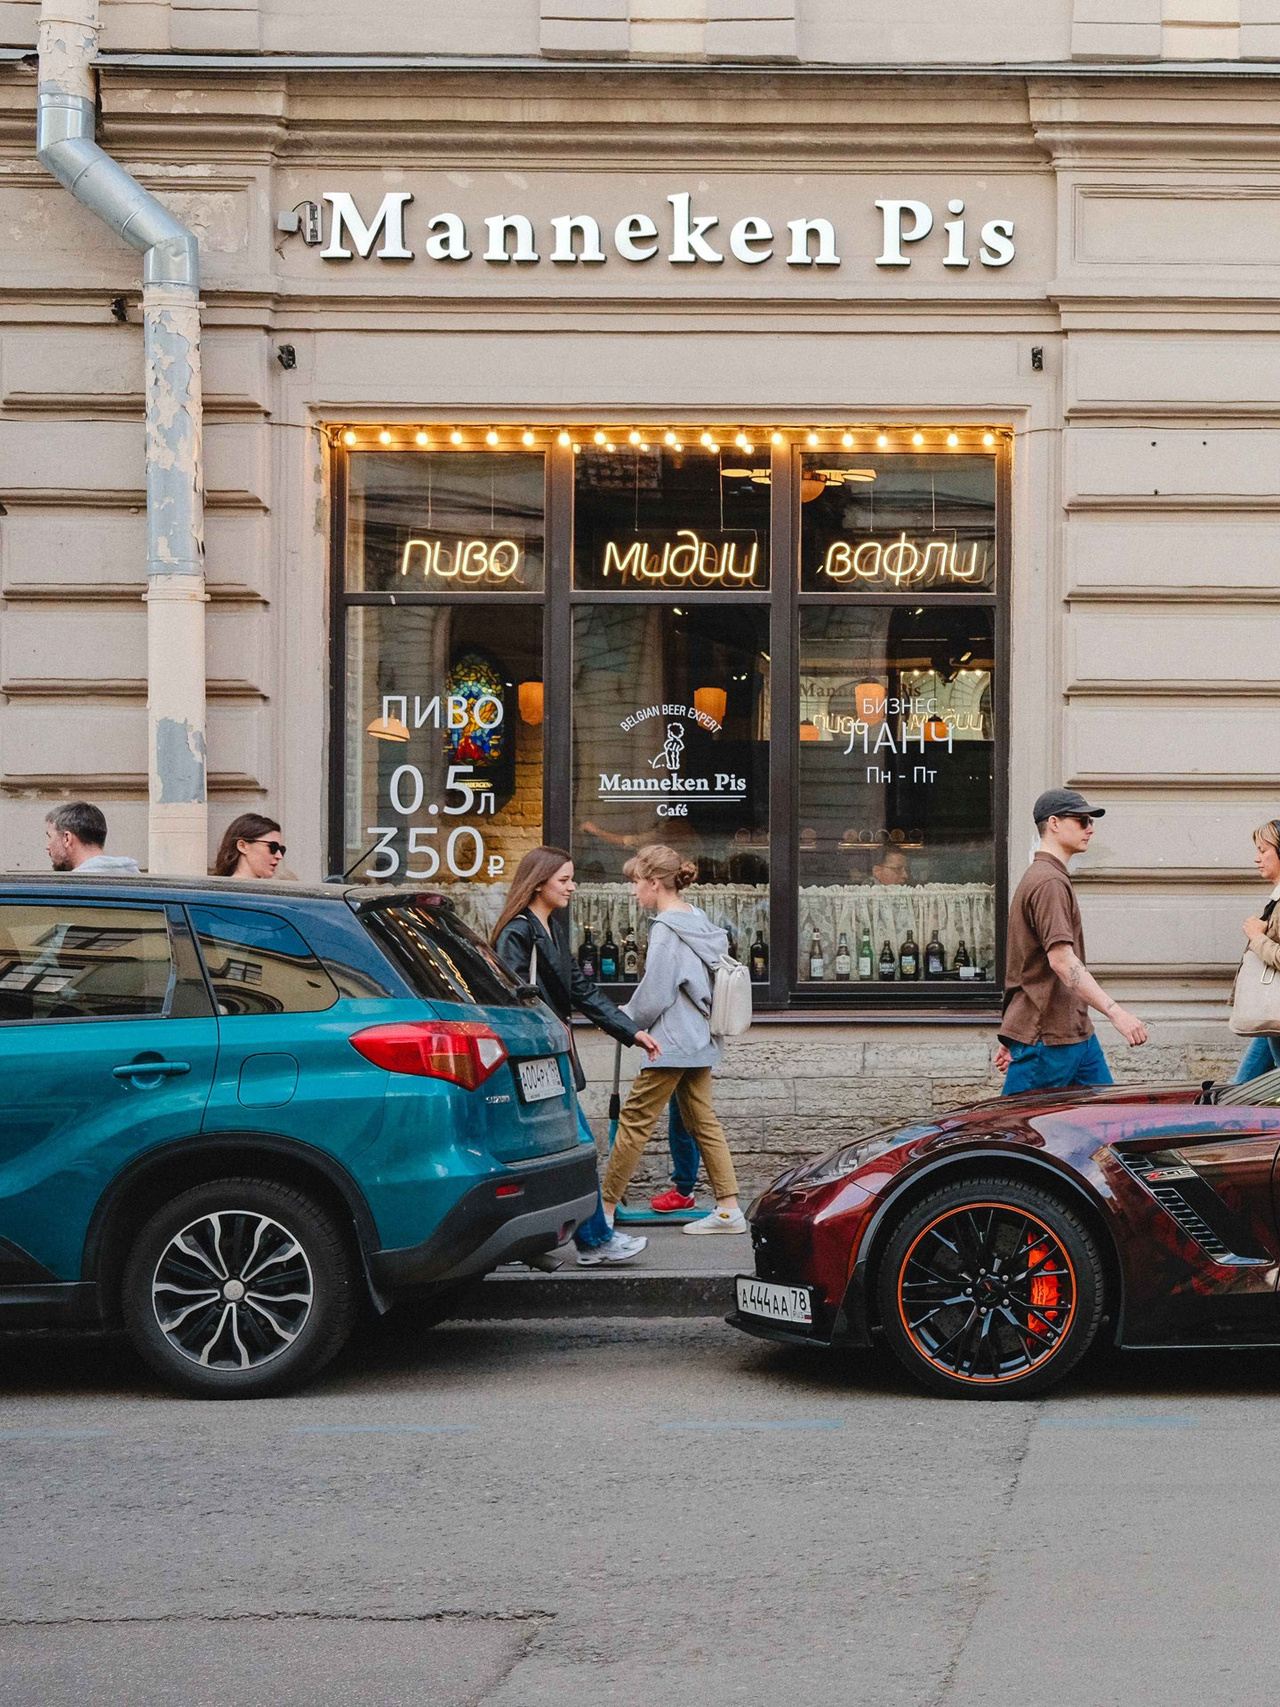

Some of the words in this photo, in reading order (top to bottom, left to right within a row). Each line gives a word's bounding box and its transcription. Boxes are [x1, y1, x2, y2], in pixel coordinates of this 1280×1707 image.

[320, 192, 841, 266] Manneken
[875, 198, 1016, 267] Pis
[401, 537, 520, 579] пиво
[602, 530, 758, 580] мидии
[823, 532, 979, 585] вафли
[382, 695, 504, 729] ПИВО
[620, 705, 660, 732] BELGIAN
[662, 704, 686, 716] BEER
[688, 707, 723, 734] EXPERT
[863, 697, 938, 715] БИЗНЕС
[843, 722, 953, 755] ЛАНЧ
[598, 773, 710, 791] Manneken
[714, 773, 747, 791] Pis
[867, 766, 891, 784] Пн
[913, 766, 937, 784] Пт
[656, 803, 688, 817] Café
[791, 1289, 807, 1311] 78
